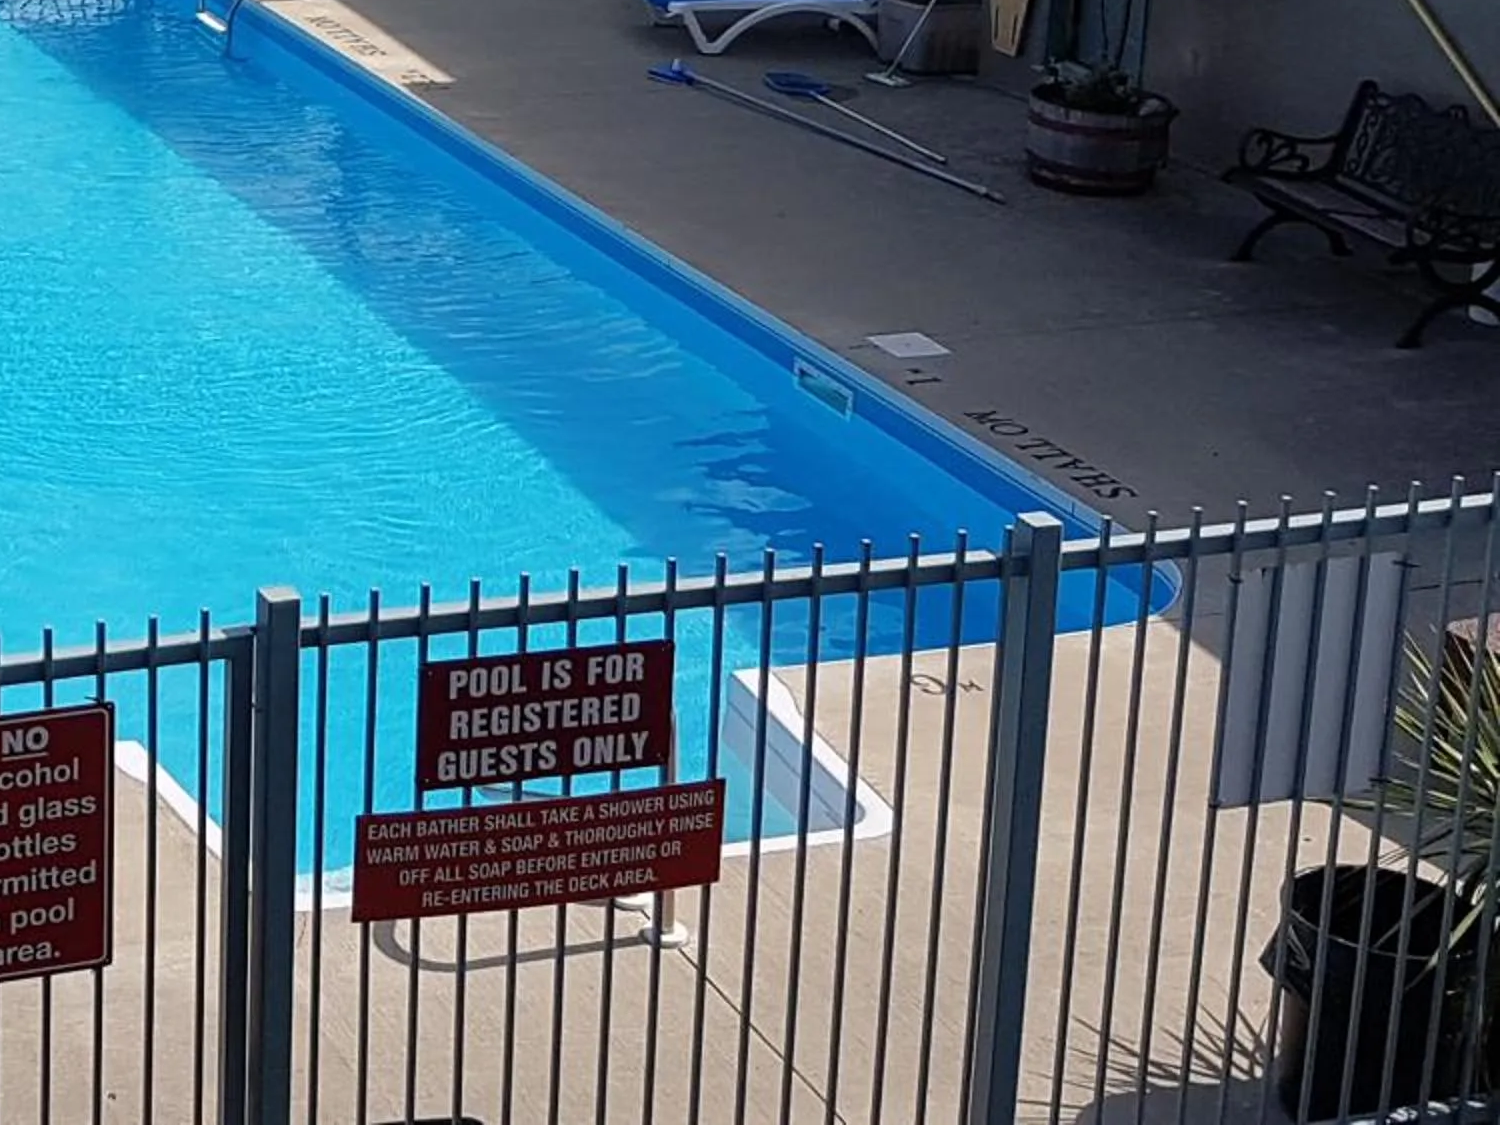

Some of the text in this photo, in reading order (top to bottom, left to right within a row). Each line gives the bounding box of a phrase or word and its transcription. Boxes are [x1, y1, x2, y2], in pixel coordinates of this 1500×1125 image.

[964, 409, 1140, 500] SHALLOW
[449, 653, 644, 700] POOL IS FOR
[450, 693, 640, 740] REGISTERED
[2, 727, 49, 754] NO
[437, 731, 649, 782] GUESTS ONLY
[19, 795, 96, 828] glass
[368, 790, 714, 840] EACH BATHER SHALL TAKE A SHOWER USING
[366, 813, 714, 864] WARM WATER & SOAP & THOROUGHLY RINSE
[399, 841, 681, 886] OFF ALL SOAP BEFORE ENTERING OR
[422, 882, 529, 907] RE-ENTERING
[534, 876, 564, 895] THE
[569, 873, 609, 892] DECK
[10, 898, 74, 935] pool
